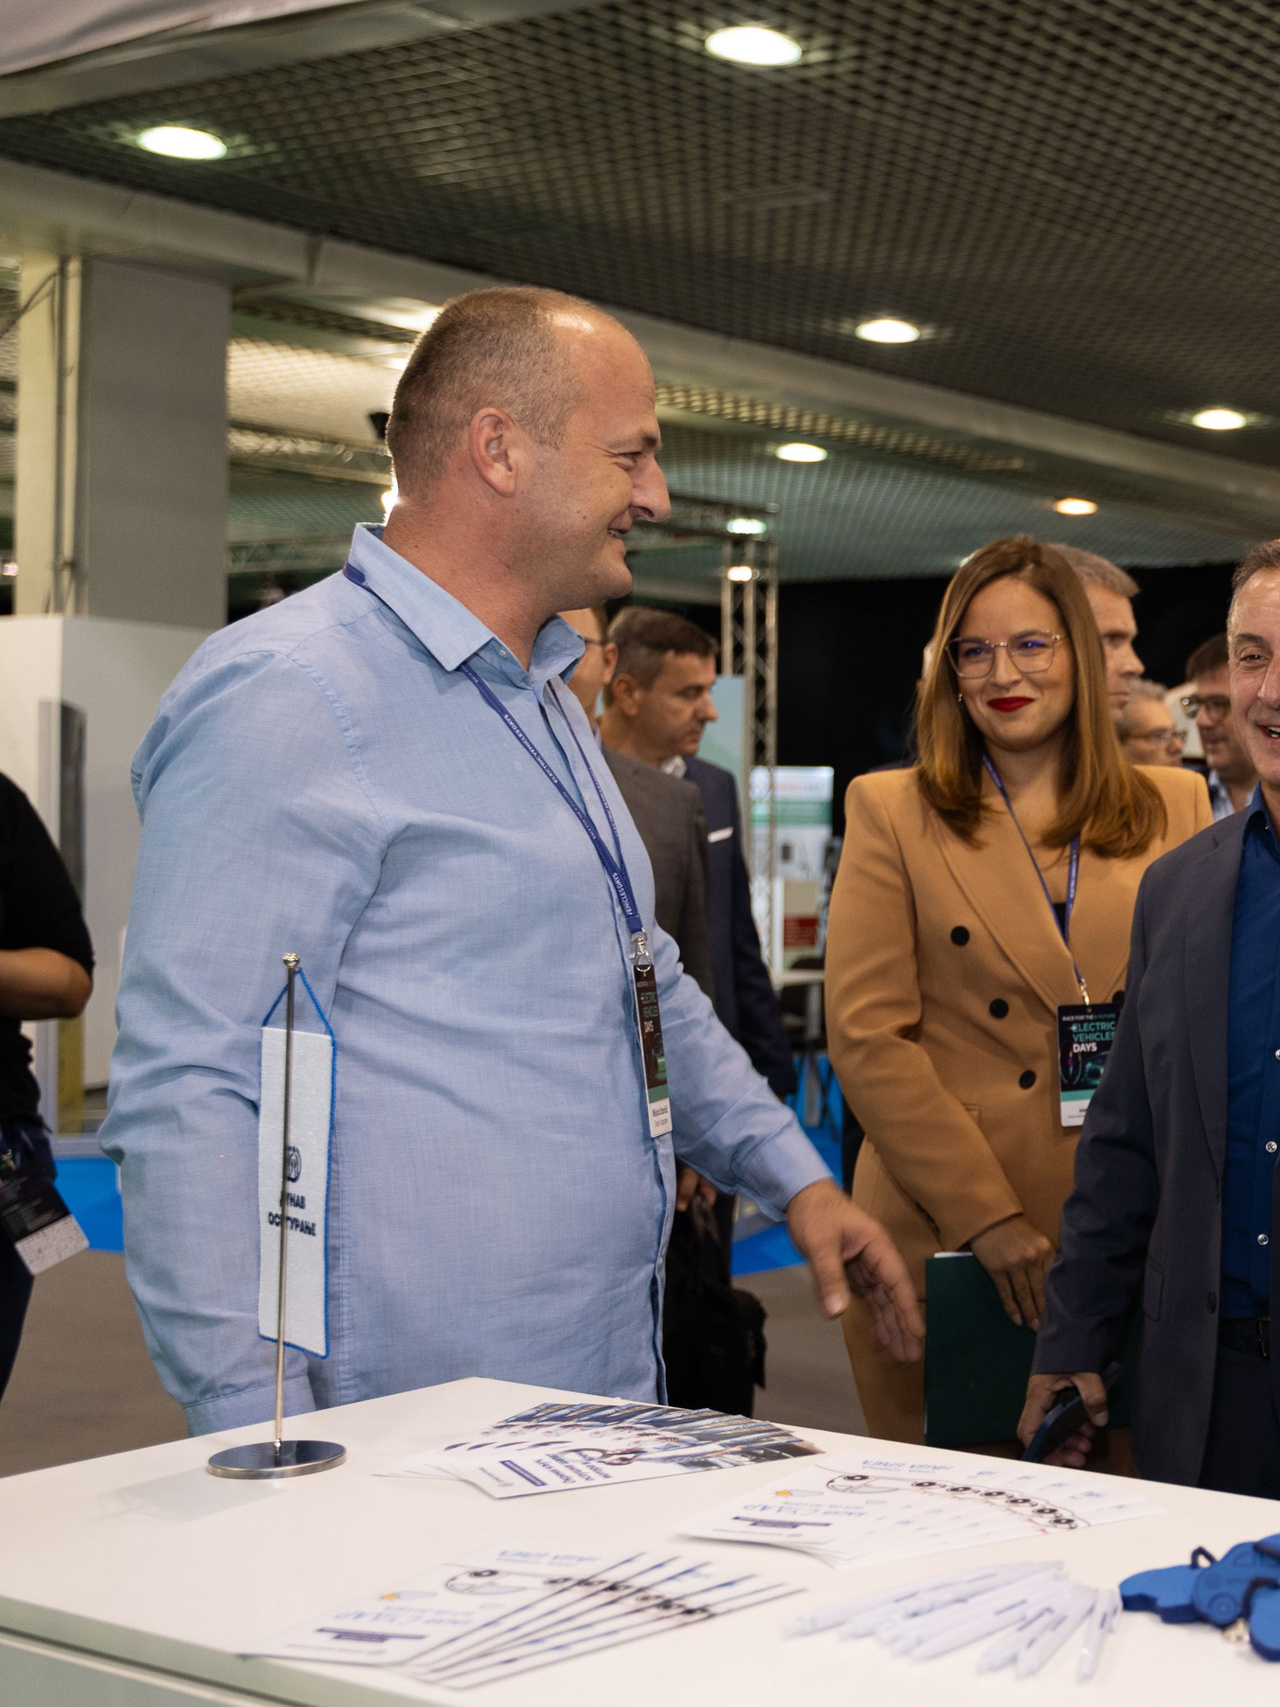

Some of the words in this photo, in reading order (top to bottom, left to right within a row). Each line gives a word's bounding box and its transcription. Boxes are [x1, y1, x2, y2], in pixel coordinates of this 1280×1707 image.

[1071, 1021, 1116, 1033] ELECTRIC
[1072, 1042, 1098, 1053] DAYS
[268, 1211, 317, 1237] ОСГУРАЊЕ
